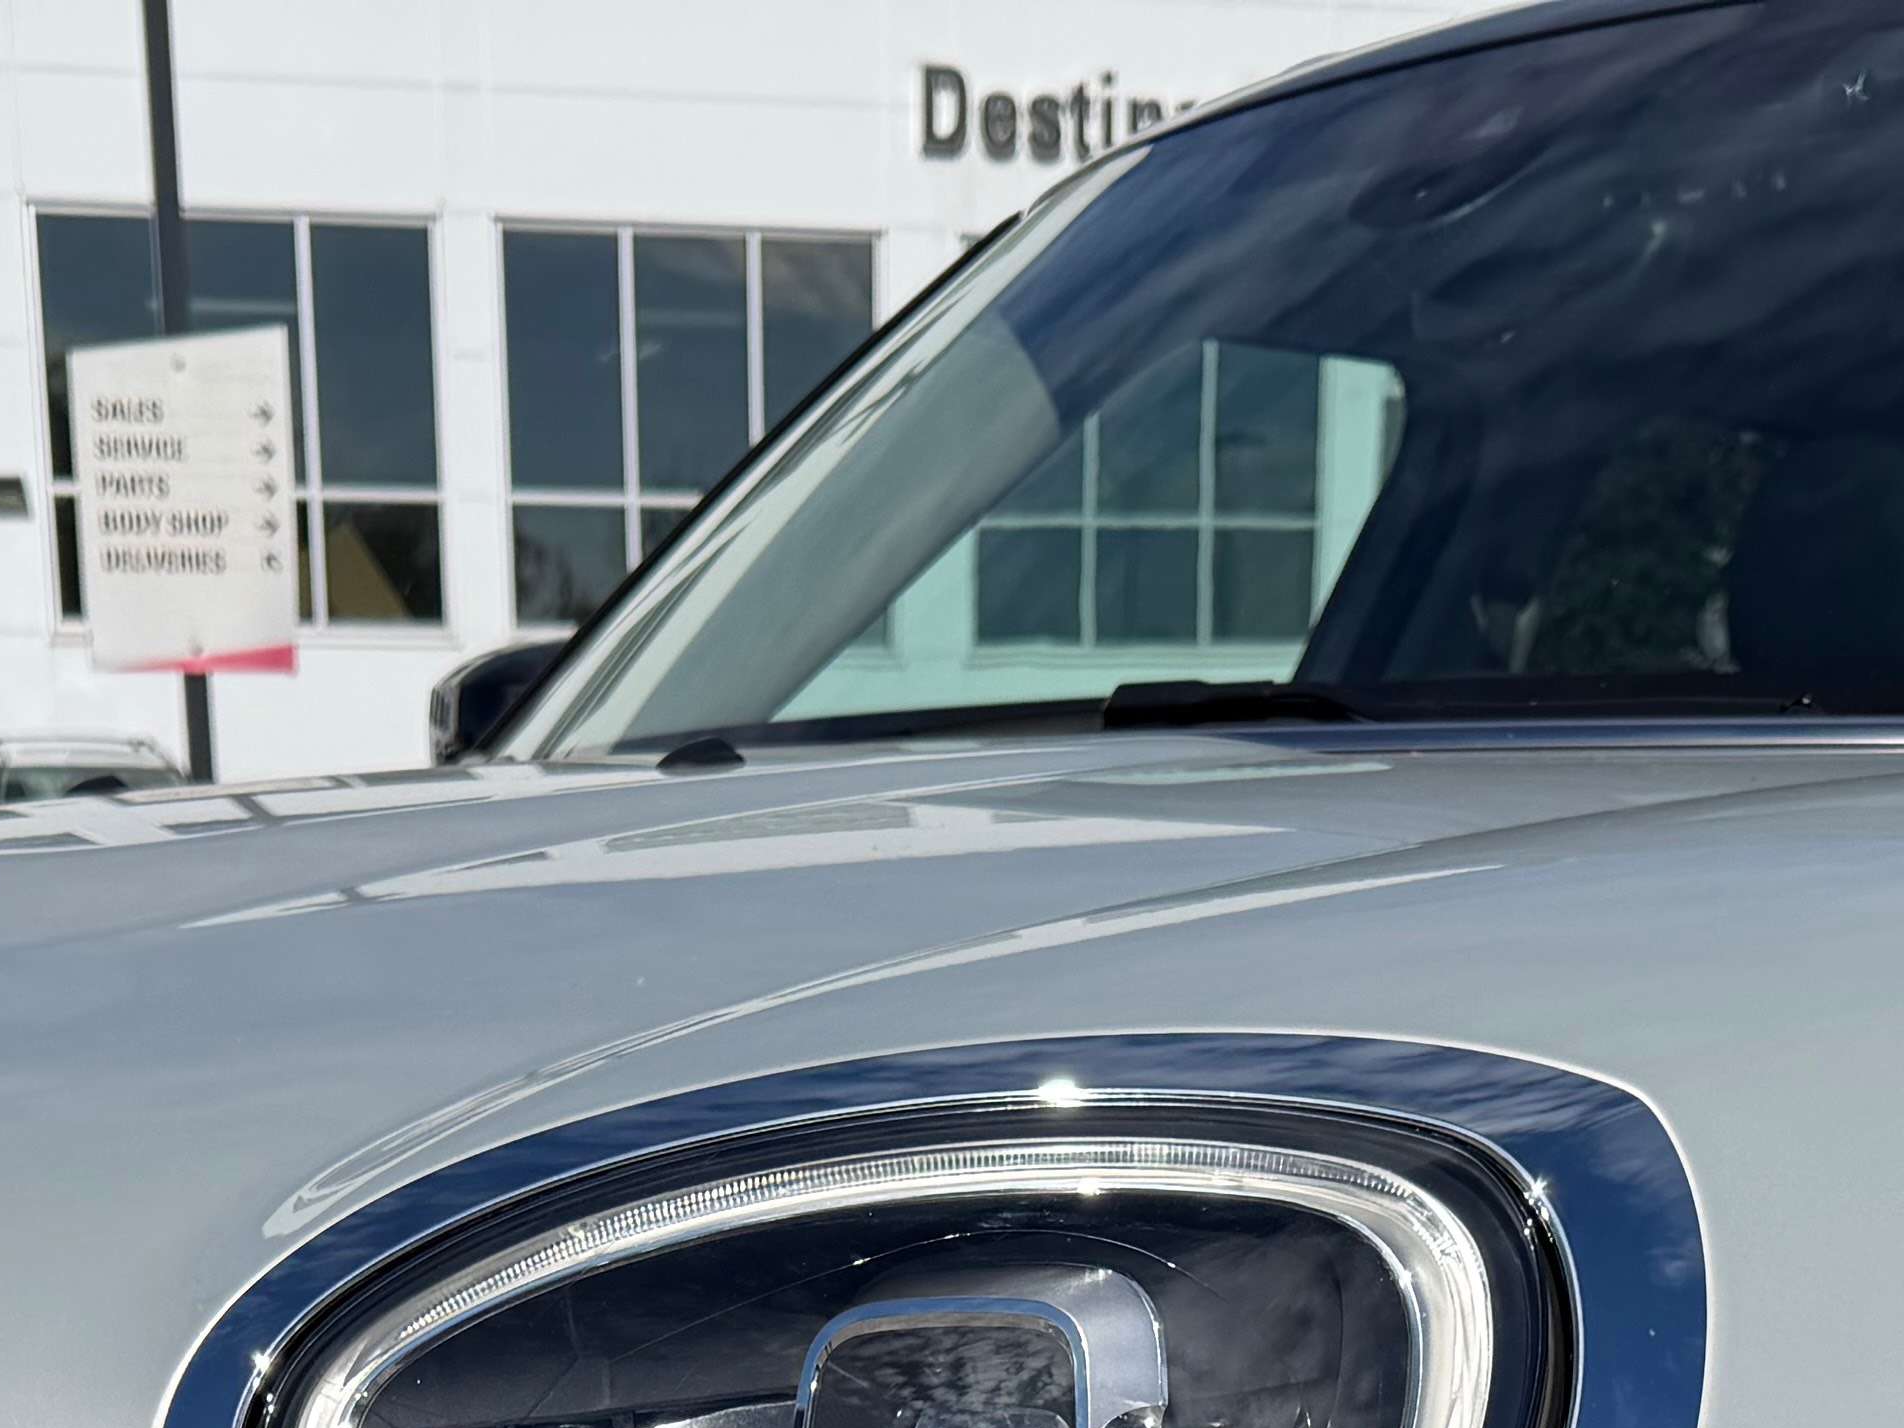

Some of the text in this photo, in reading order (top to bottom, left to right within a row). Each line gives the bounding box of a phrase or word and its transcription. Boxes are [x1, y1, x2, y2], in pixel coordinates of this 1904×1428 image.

[922, 65, 1196, 161] Destin
[92, 397, 165, 423] SALES
[95, 434, 189, 462] SERVICE
[98, 471, 170, 499] PARTS
[99, 509, 230, 537] BODY SHOP
[100, 546, 228, 575] DELIVERIES
